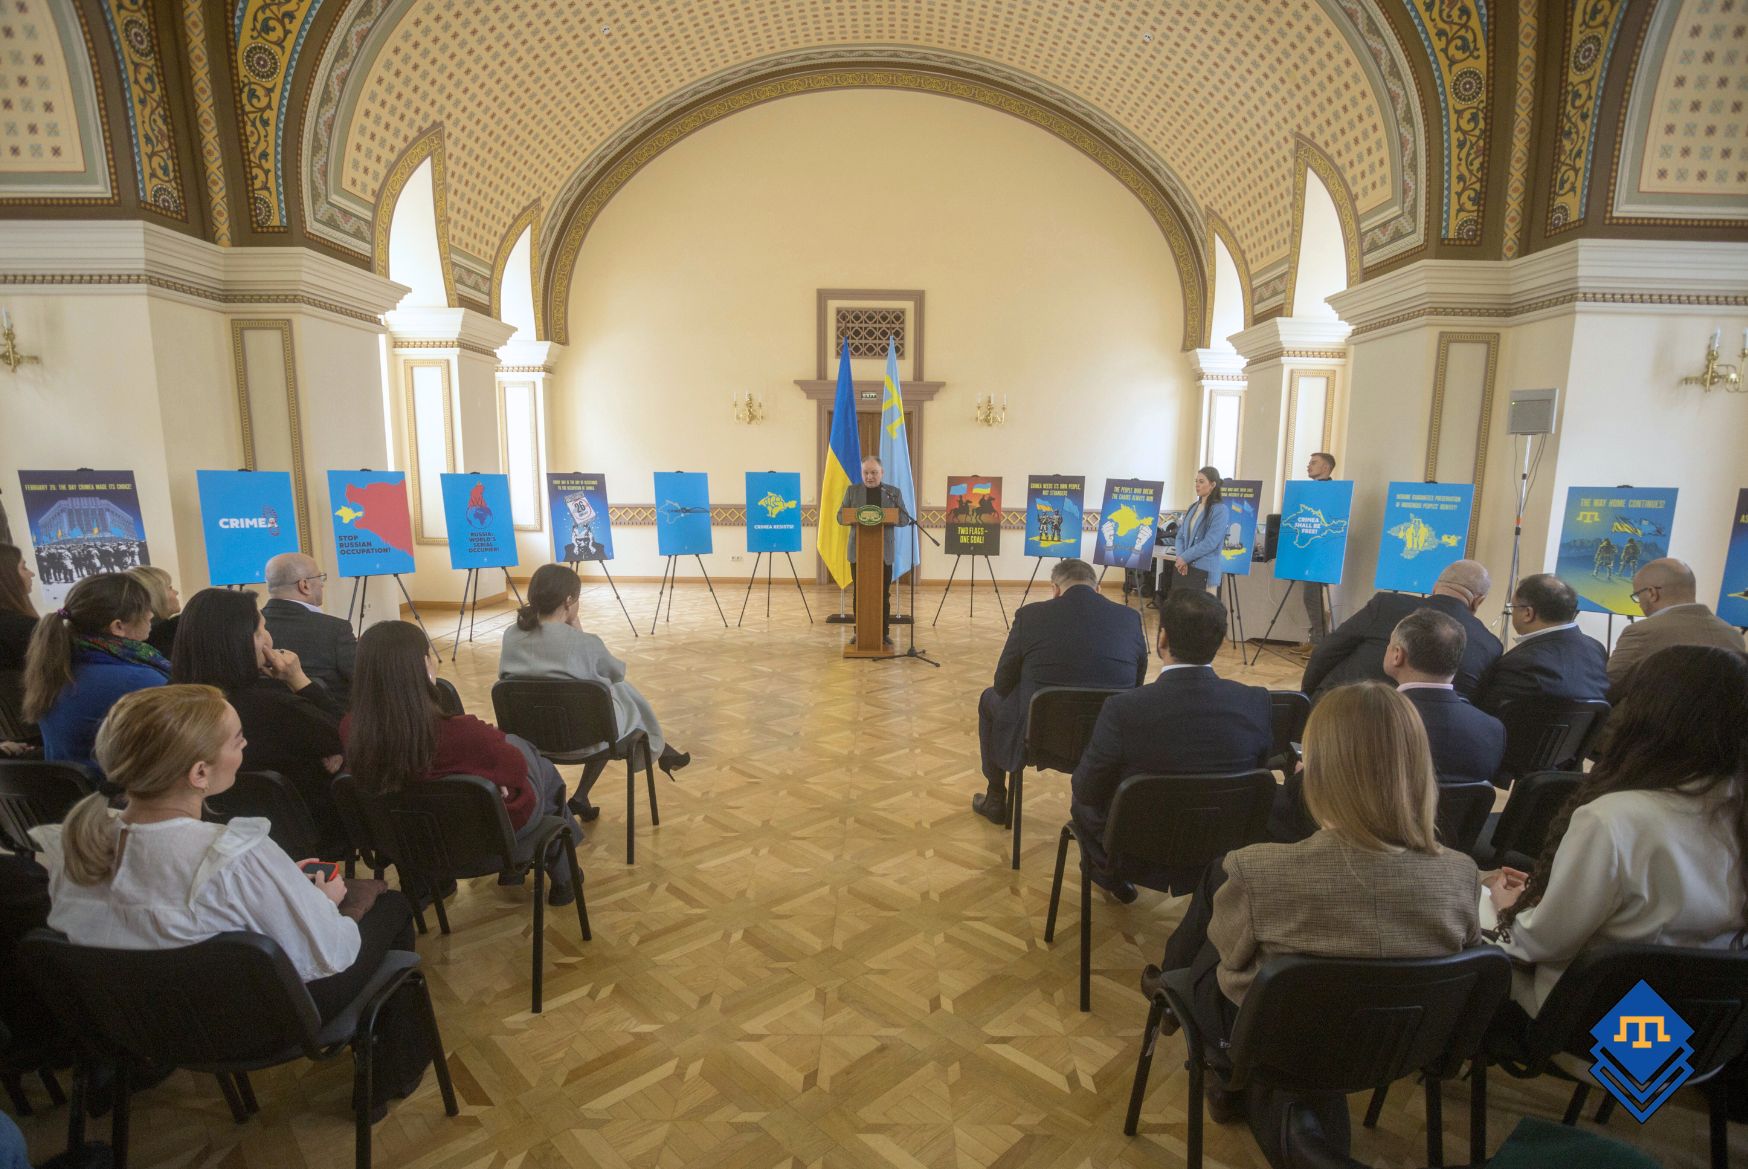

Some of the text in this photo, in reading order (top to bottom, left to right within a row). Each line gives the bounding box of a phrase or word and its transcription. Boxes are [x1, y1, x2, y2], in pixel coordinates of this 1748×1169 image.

[574, 500, 586, 513] 26
[218, 517, 278, 529] CRIMEA
[957, 526, 969, 535] TWO
[959, 535, 970, 544] ONE
[339, 541, 373, 549] RUSSIAN
[340, 547, 391, 556] OCCUPATION!
